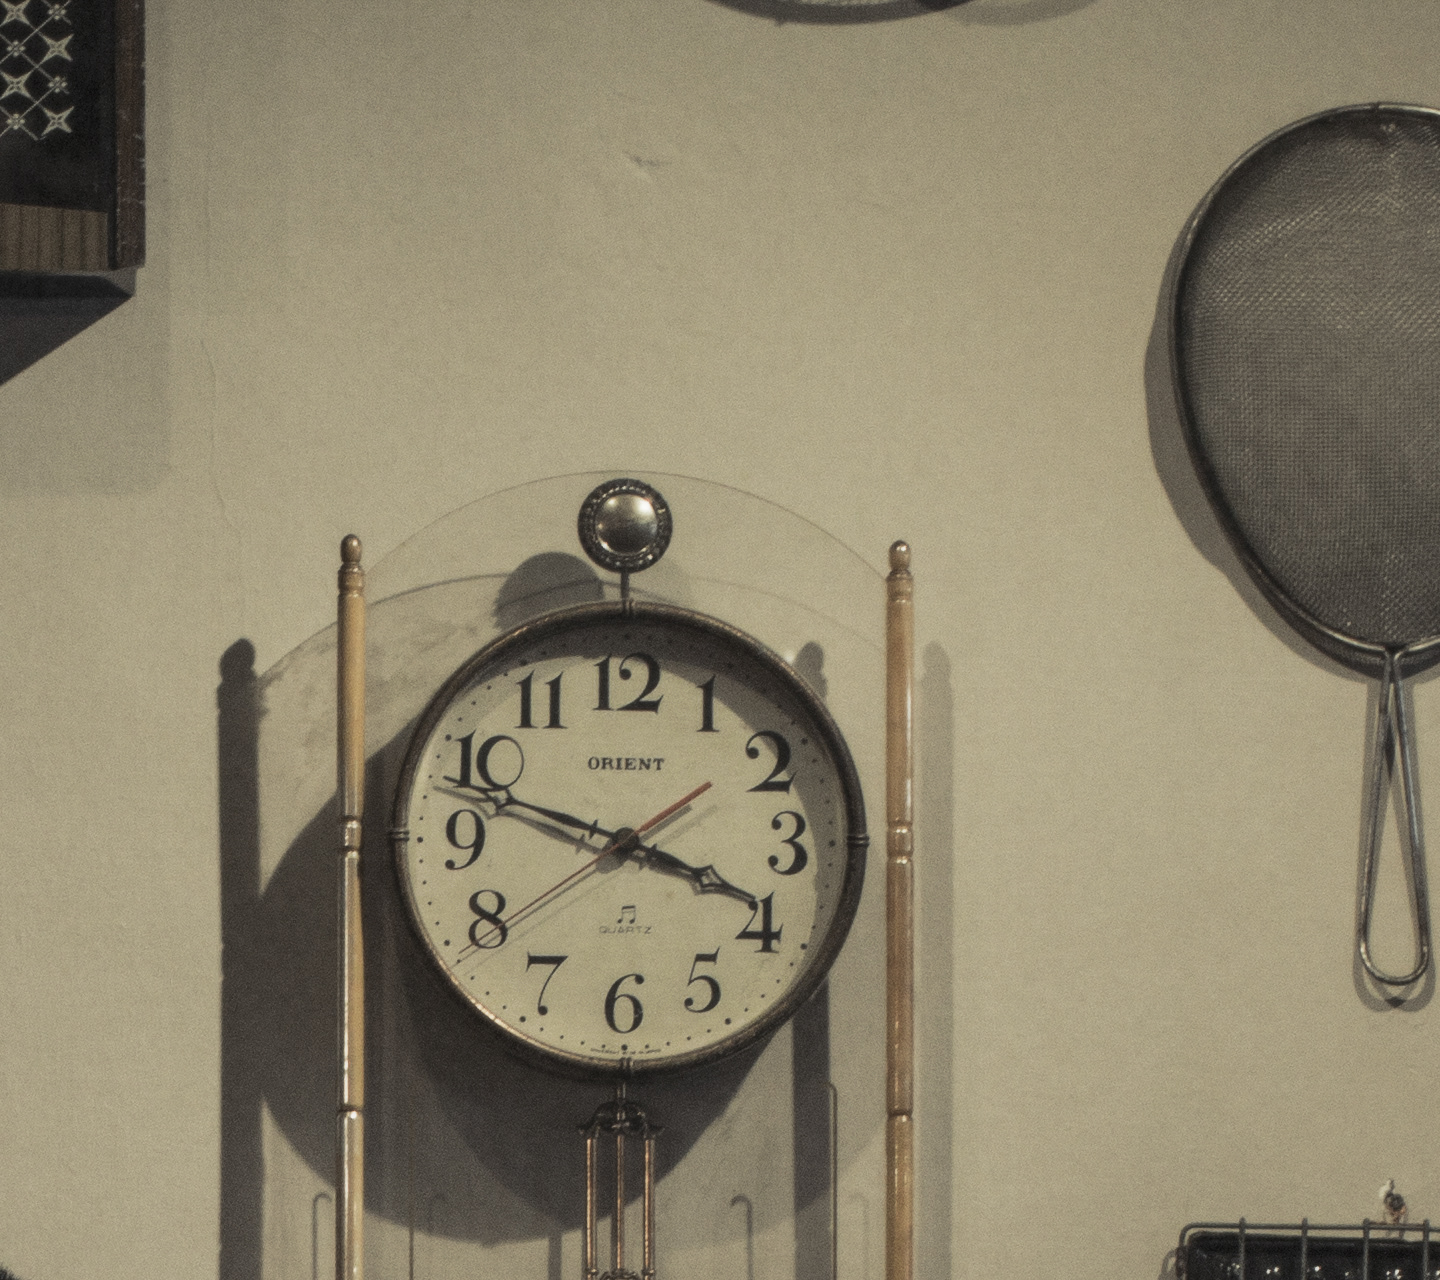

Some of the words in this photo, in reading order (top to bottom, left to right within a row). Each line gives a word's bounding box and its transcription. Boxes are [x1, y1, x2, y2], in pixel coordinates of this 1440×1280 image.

[515, 671, 568, 729] 11
[593, 652, 664, 714] 12
[696, 675, 720, 733] 1
[452, 729, 525, 789] 10
[587, 756, 665, 771] ORIENT
[745, 730, 797, 793] 2
[444, 809, 486, 870] 9
[768, 810, 808, 876] 3
[467, 888, 509, 949] 8
[598, 925, 653, 935] QUARTZ
[735, 892, 784, 954] 4
[525, 951, 569, 1016] 7
[603, 973, 645, 1033] 6
[683, 946, 722, 1013] 5
